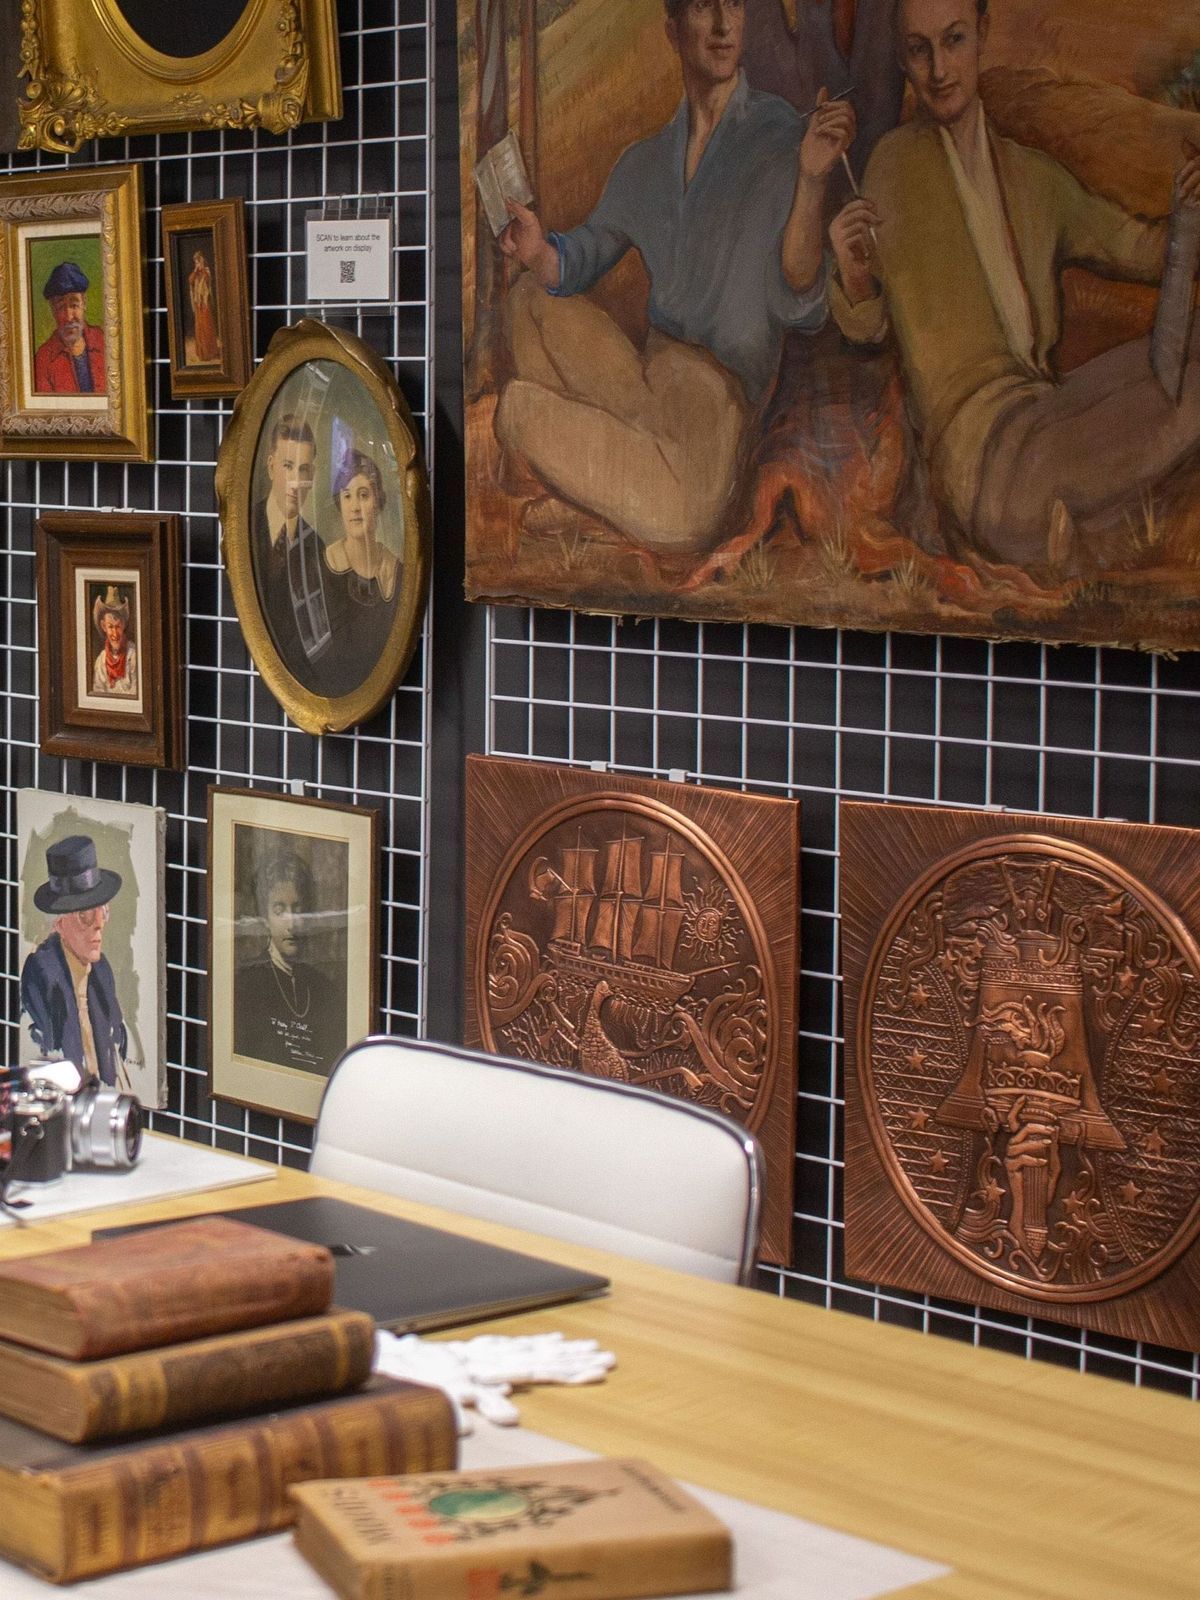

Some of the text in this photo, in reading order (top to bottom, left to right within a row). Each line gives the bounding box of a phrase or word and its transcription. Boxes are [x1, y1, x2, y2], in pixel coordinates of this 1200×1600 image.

[316, 234, 333, 242] SCAN
[340, 234, 353, 242] learn
[353, 244, 372, 253] display
